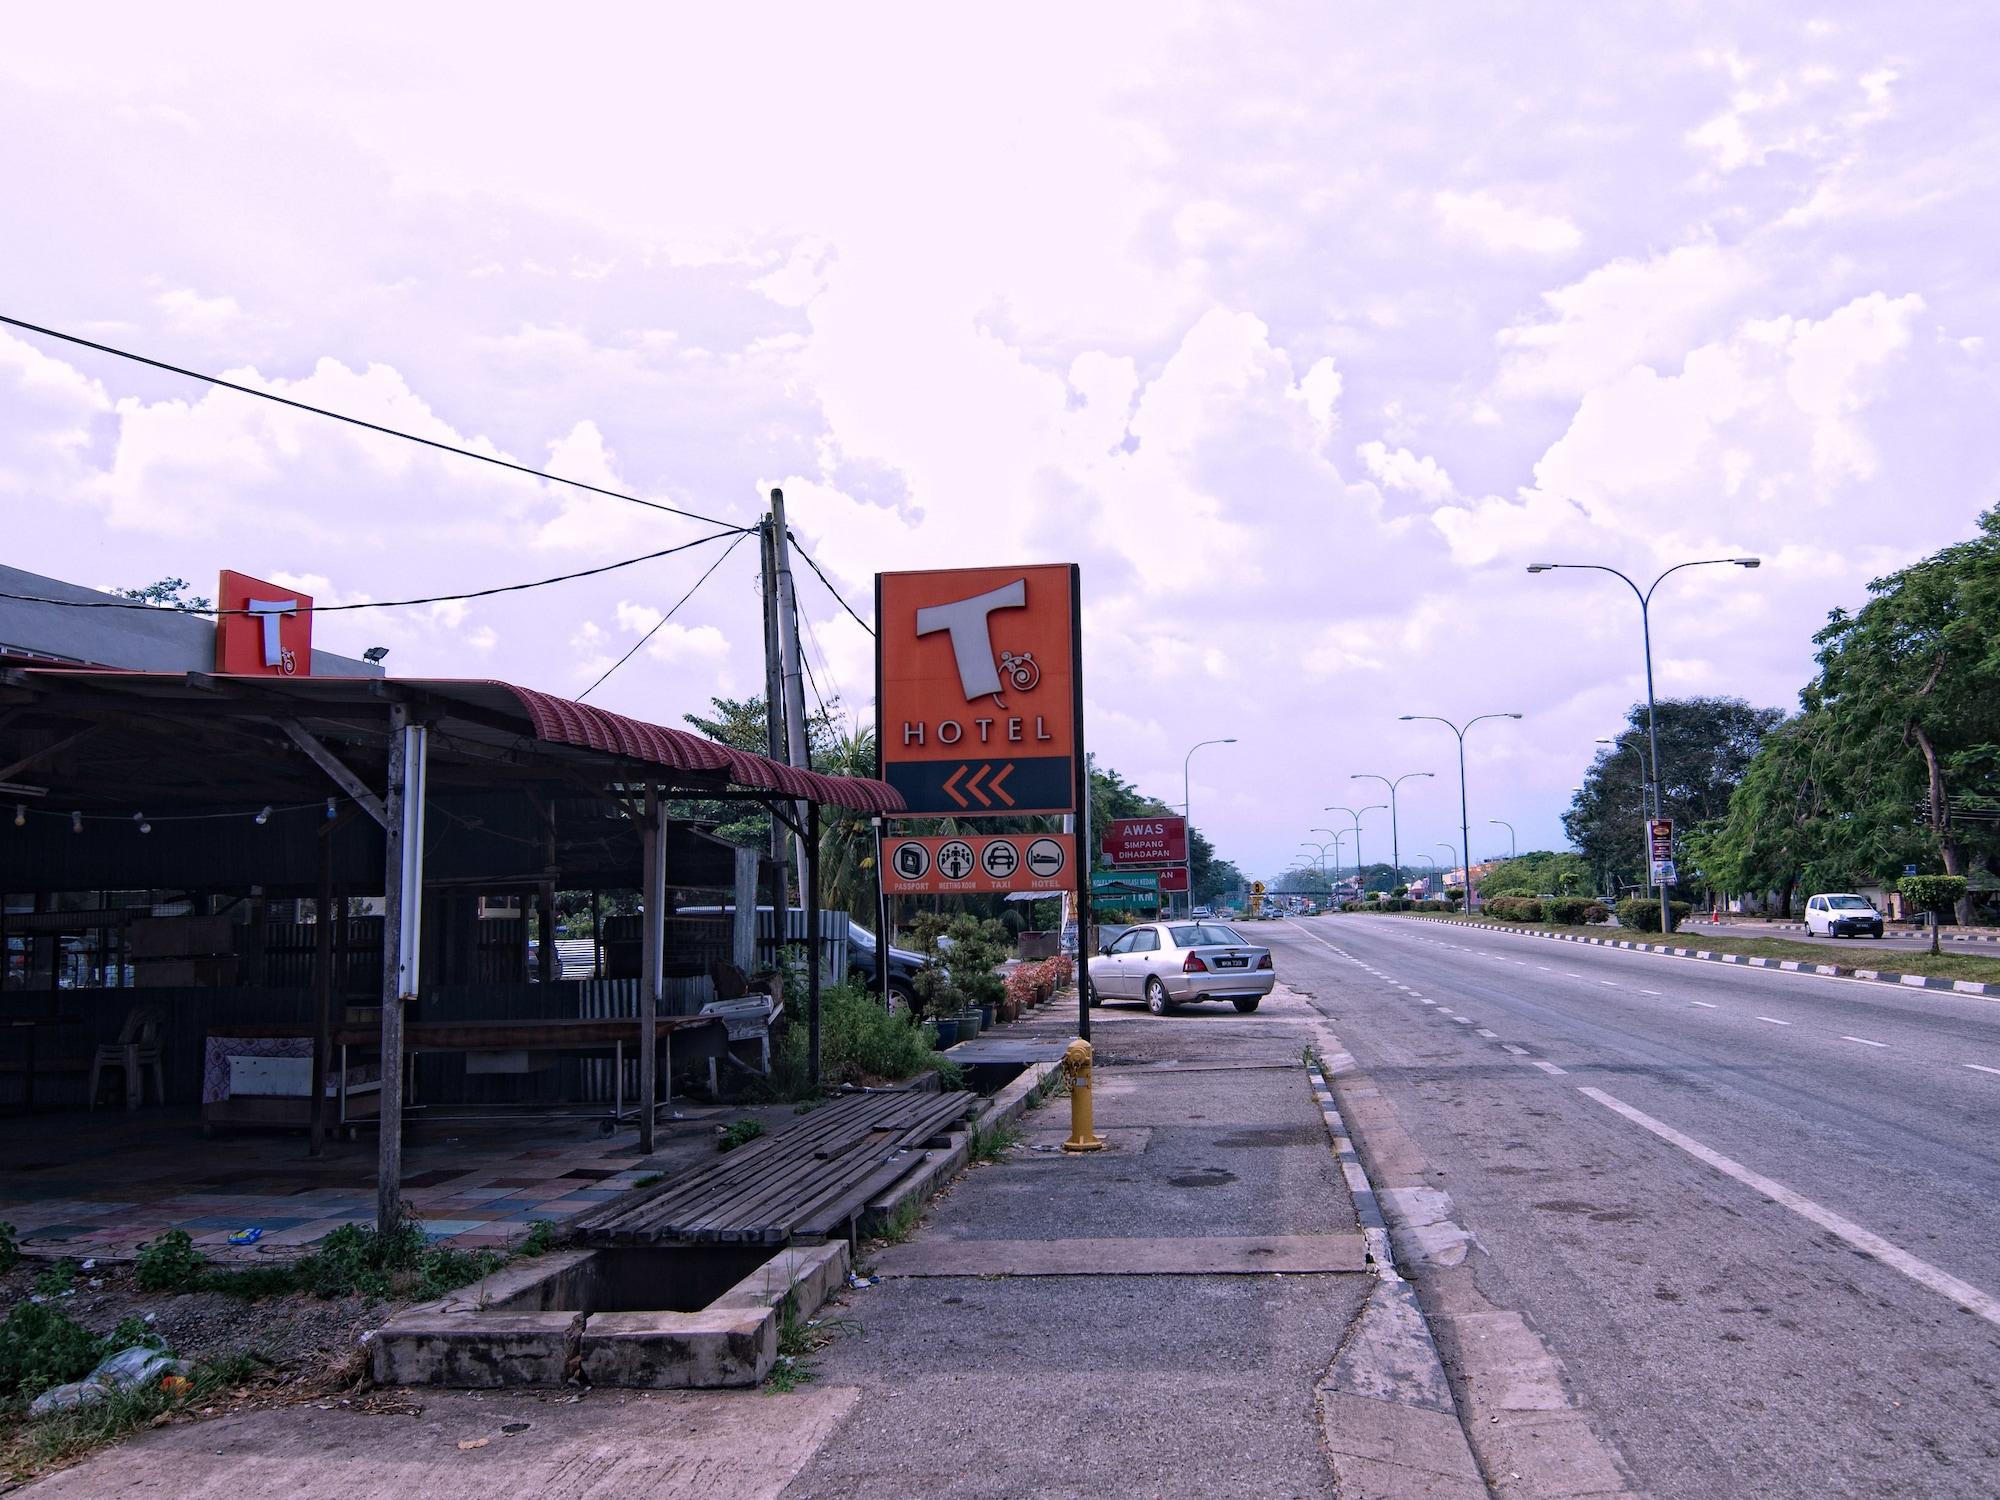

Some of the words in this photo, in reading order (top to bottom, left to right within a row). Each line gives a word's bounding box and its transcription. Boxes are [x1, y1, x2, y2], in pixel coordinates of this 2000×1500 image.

[904, 716, 1051, 745] HOTEL
[1123, 824, 1164, 836] AWAS
[1124, 840, 1164, 849] SIMPANG
[1119, 850, 1170, 859] DIHADAPAN
[894, 882, 930, 891] PASSPORT
[938, 881, 961, 890] MEETING
[961, 881, 977, 889] ROOM
[991, 880, 1011, 888] TAXI
[1032, 880, 1061, 888] HOTEL
